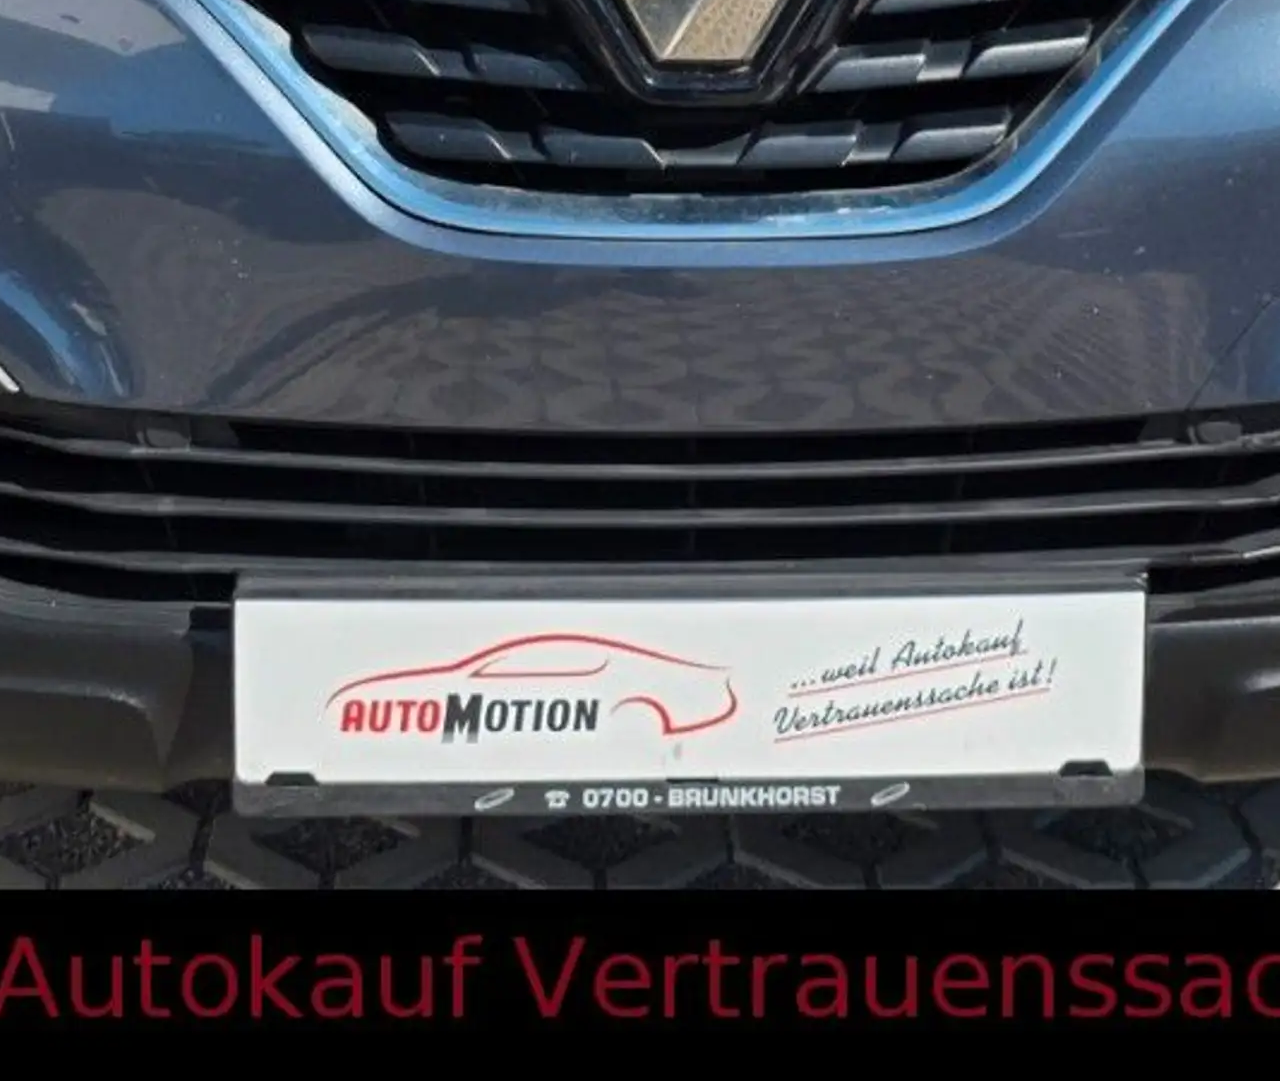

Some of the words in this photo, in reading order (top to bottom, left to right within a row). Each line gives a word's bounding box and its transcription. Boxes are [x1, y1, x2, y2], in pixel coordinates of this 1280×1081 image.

[791, 647, 881, 688] ...weil
[891, 618, 1024, 670] Autokauf
[773, 672, 1000, 734] Vertrauenssache
[582, 788, 649, 808] 0700
[668, 786, 841, 808] BRUNKHORST
